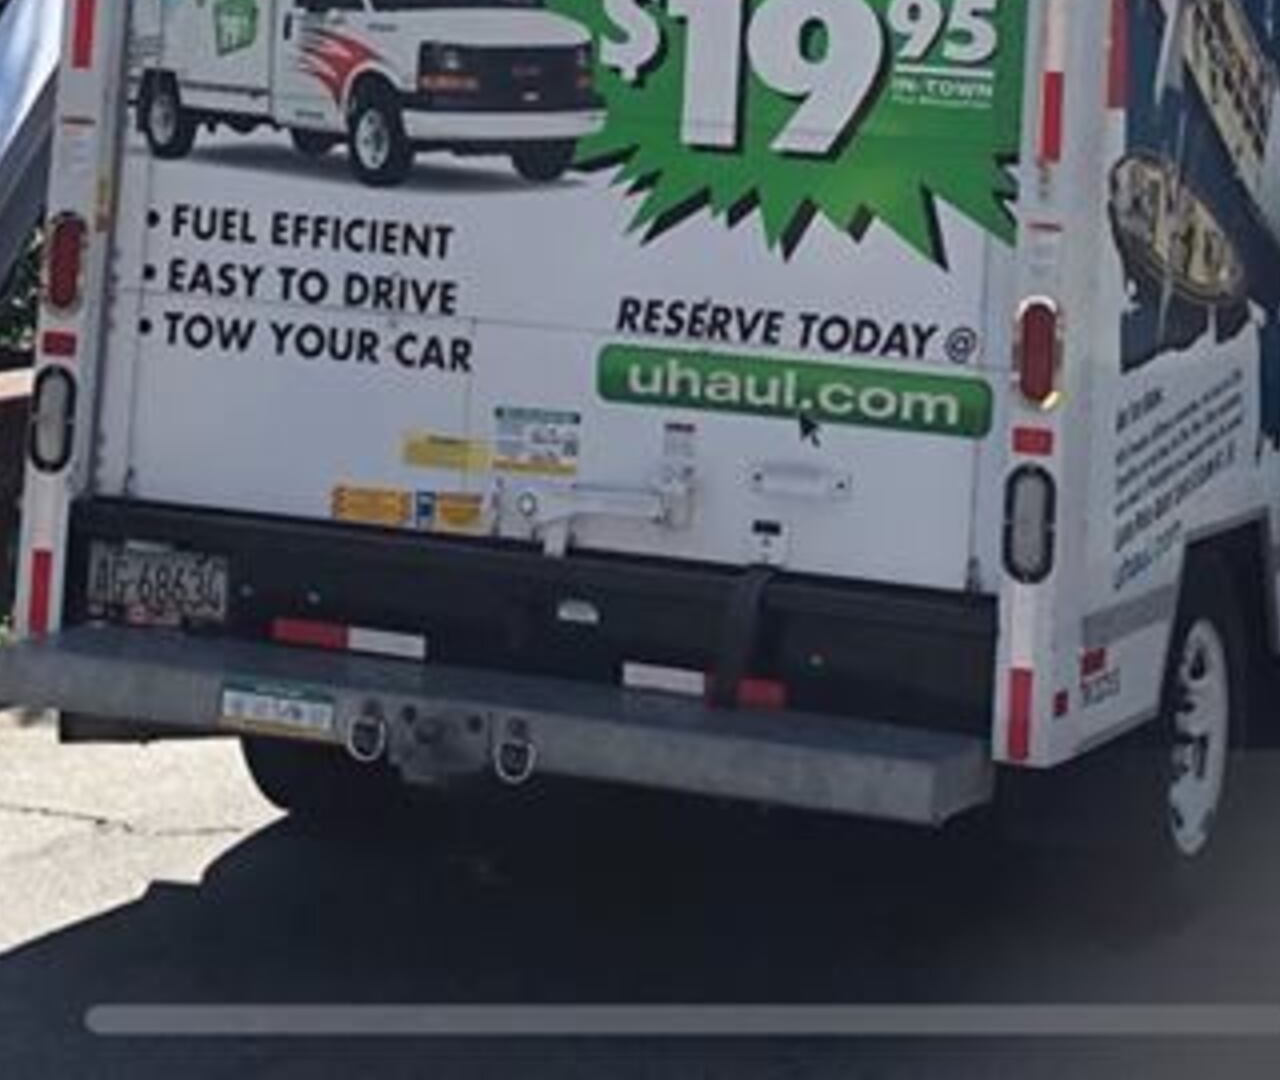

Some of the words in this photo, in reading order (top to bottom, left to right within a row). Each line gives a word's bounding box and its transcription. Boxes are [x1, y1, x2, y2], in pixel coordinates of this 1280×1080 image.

[172, 204, 257, 245] FUEL
[271, 211, 455, 260] EFFICIENT
[167, 258, 264, 298] EASY
[277, 267, 329, 305] TO
[344, 272, 459, 316] DRIVE
[164, 311, 257, 353] TOW
[271, 322, 381, 366] YOUR
[393, 331, 474, 374] CAR
[616, 296, 785, 347] RESERVE
[798, 313, 938, 358] TODAY
[944, 327, 978, 364] @
[627, 358, 961, 425] uhaul.com
